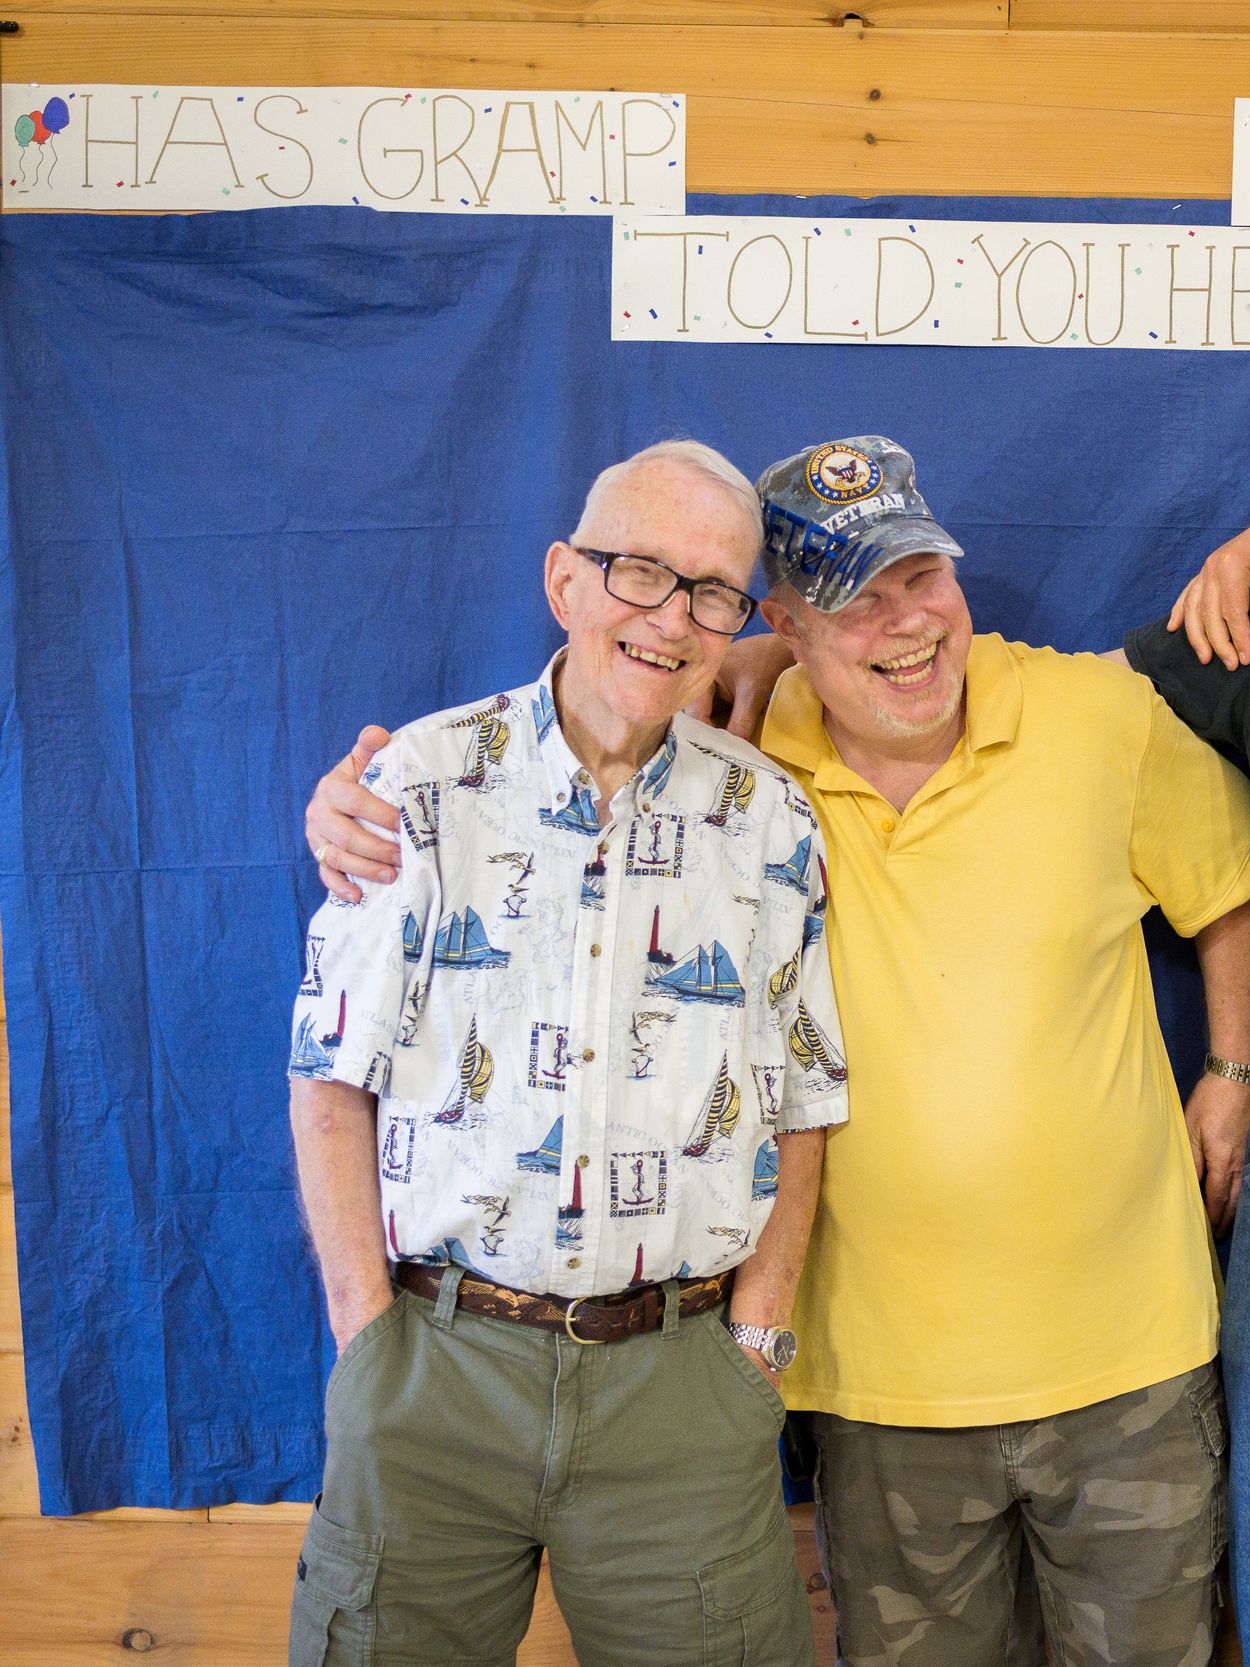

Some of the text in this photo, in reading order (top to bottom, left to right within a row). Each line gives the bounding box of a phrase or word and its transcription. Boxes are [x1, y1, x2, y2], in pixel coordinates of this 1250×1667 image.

[80, 94, 676, 207] HAS GRAMP
[634, 230, 935, 340] TOLD
[971, 234, 1131, 345] YOU
[811, 445, 870, 475] UNITED STATES
[840, 483, 871, 499] NAVY
[822, 493, 906, 536] VETERAN
